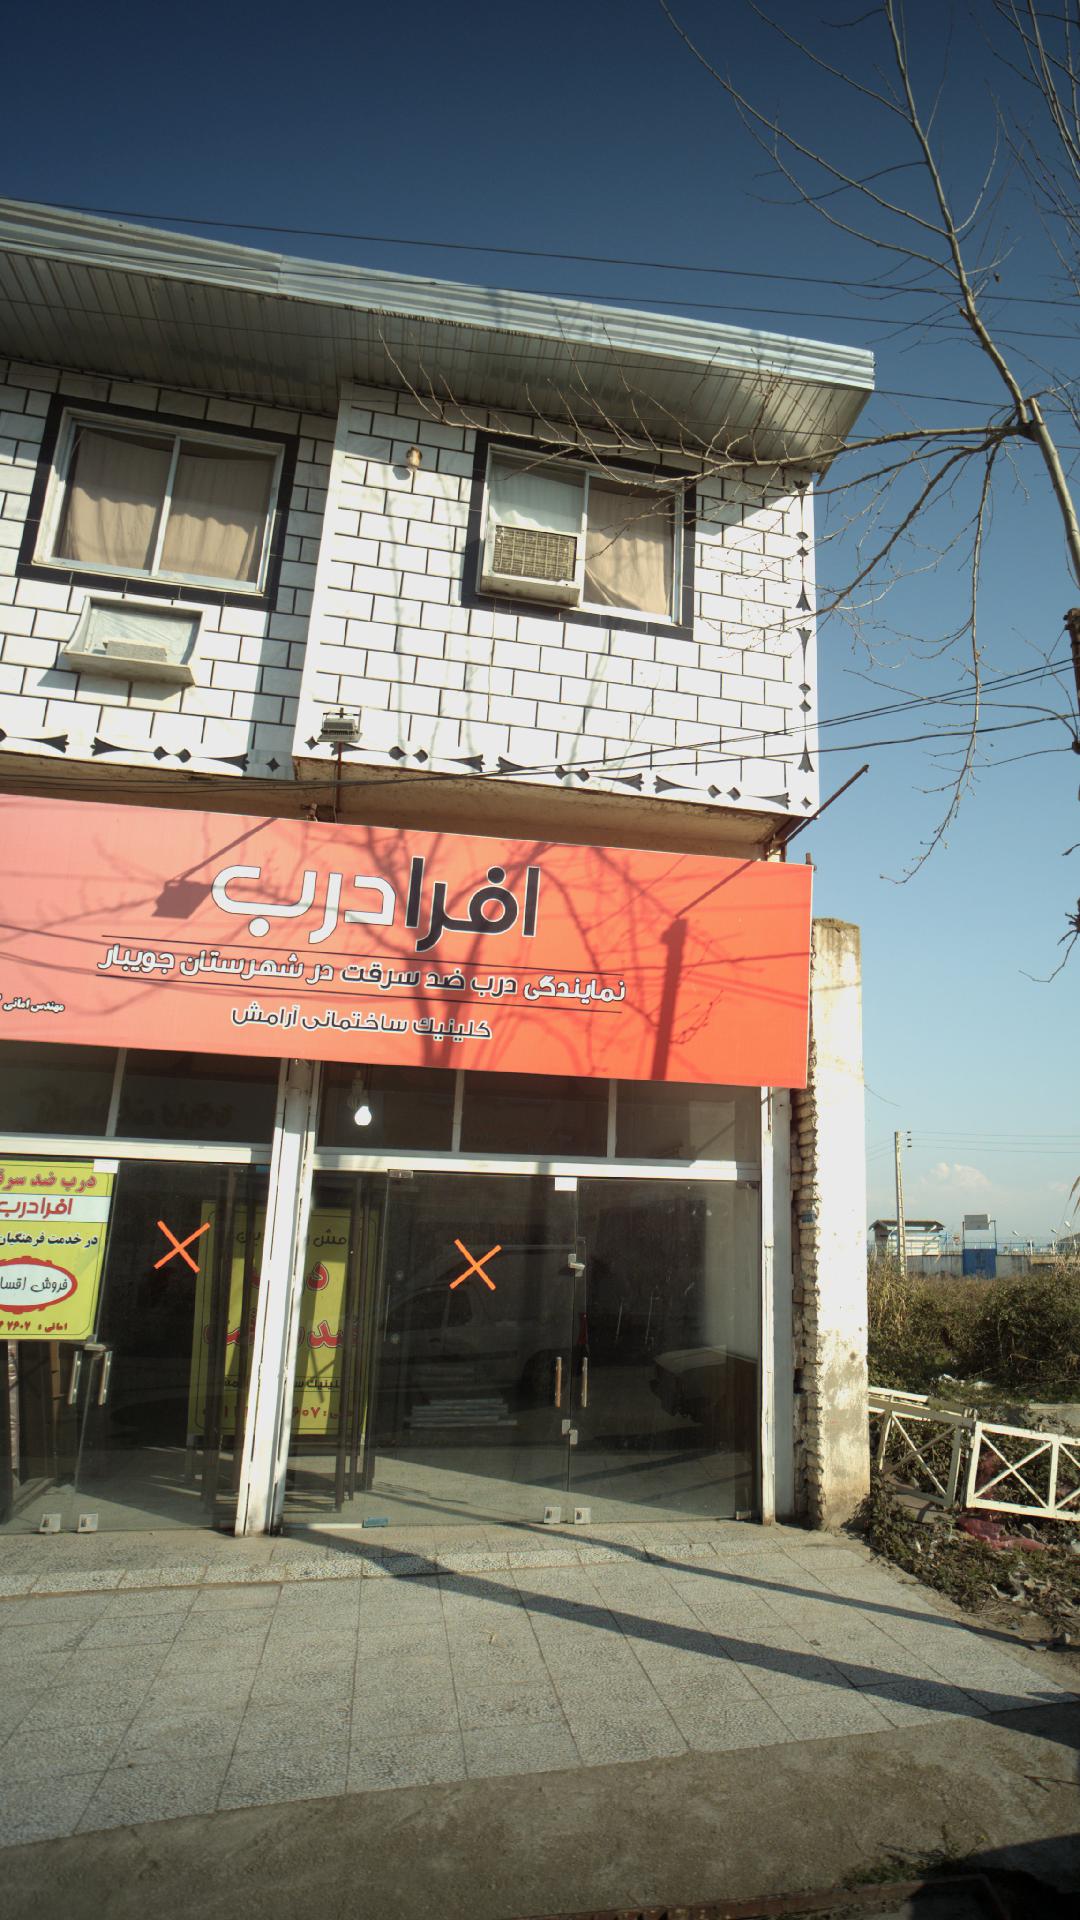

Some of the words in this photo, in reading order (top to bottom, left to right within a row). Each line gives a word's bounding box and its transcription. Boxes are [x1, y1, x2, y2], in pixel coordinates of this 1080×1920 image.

[211, 864, 396, 944] درب
[405, 856, 540, 952] افرا
[97, 943, 175, 974] جویبار
[180, 950, 303, 980] شهرستان
[306, 961, 334, 984] در
[340, 963, 420, 989] سرقت
[425, 968, 465, 990] ضد
[471, 975, 517, 998] درب
[523, 976, 626, 1004] نمایندگی
[30, 1001, 65, 1013] مهندس
[231, 1001, 301, 1029] آرامش
[302, 1010, 407, 1034] ساختمانی
[31, 1171, 57, 1187] ضد
[61, 1175, 97, 1193] درب
[0, 1200, 39, 1218] درب
[41, 1197, 74, 1219] افرا
[48, 1234, 82, 1245] خدمت
[84, 1235, 98, 1248] در
[0, 1276, 27, 1291] اقسا
[30, 1277, 68, 1293] فروش
